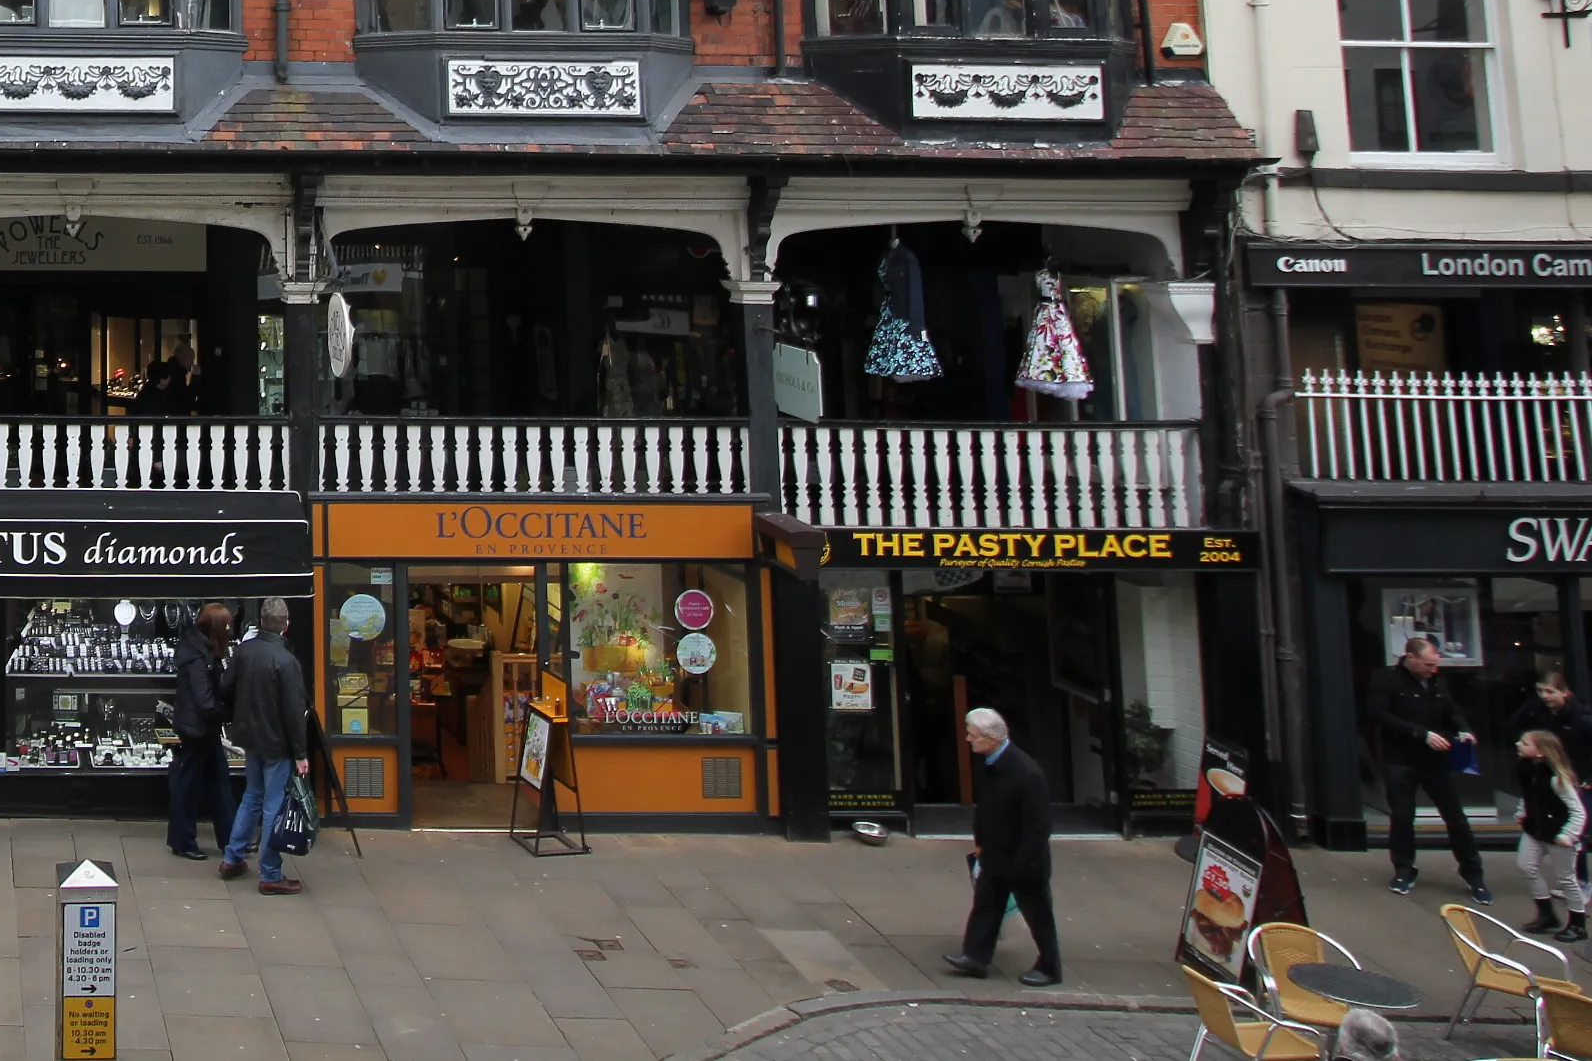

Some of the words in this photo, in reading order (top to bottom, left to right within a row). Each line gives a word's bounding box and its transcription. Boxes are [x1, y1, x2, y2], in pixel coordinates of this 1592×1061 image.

[35, 236, 61, 250] THE
[11, 250, 86, 265] JEWELLERS
[1276, 256, 1347, 272] Canon
[1421, 253, 1526, 276] London
[83, 532, 244, 565] diamonds
[475, 544, 497, 554] EN
[509, 544, 608, 554] PROVENCE
[852, 532, 925, 557] THE
[933, 533, 1046, 557] PASTY
[1053, 534, 1172, 558] PLACE
[1199, 551, 1241, 562] 2004
[939, 558, 977, 569] Purveyor
[977, 558, 987, 568] of
[987, 559, 1019, 569] Quality
[1021, 558, 1055, 568] Cornish
[1056, 559, 1086, 567] Pasties
[73, 931, 106, 939] Disabled
[77, 939, 101, 948] badge
[69, 947, 98, 955] holders
[66, 956, 94, 965] loading
[96, 956, 112, 965] only
[82, 1011, 110, 1020] waiting
[80, 1019, 108, 1028] loading
